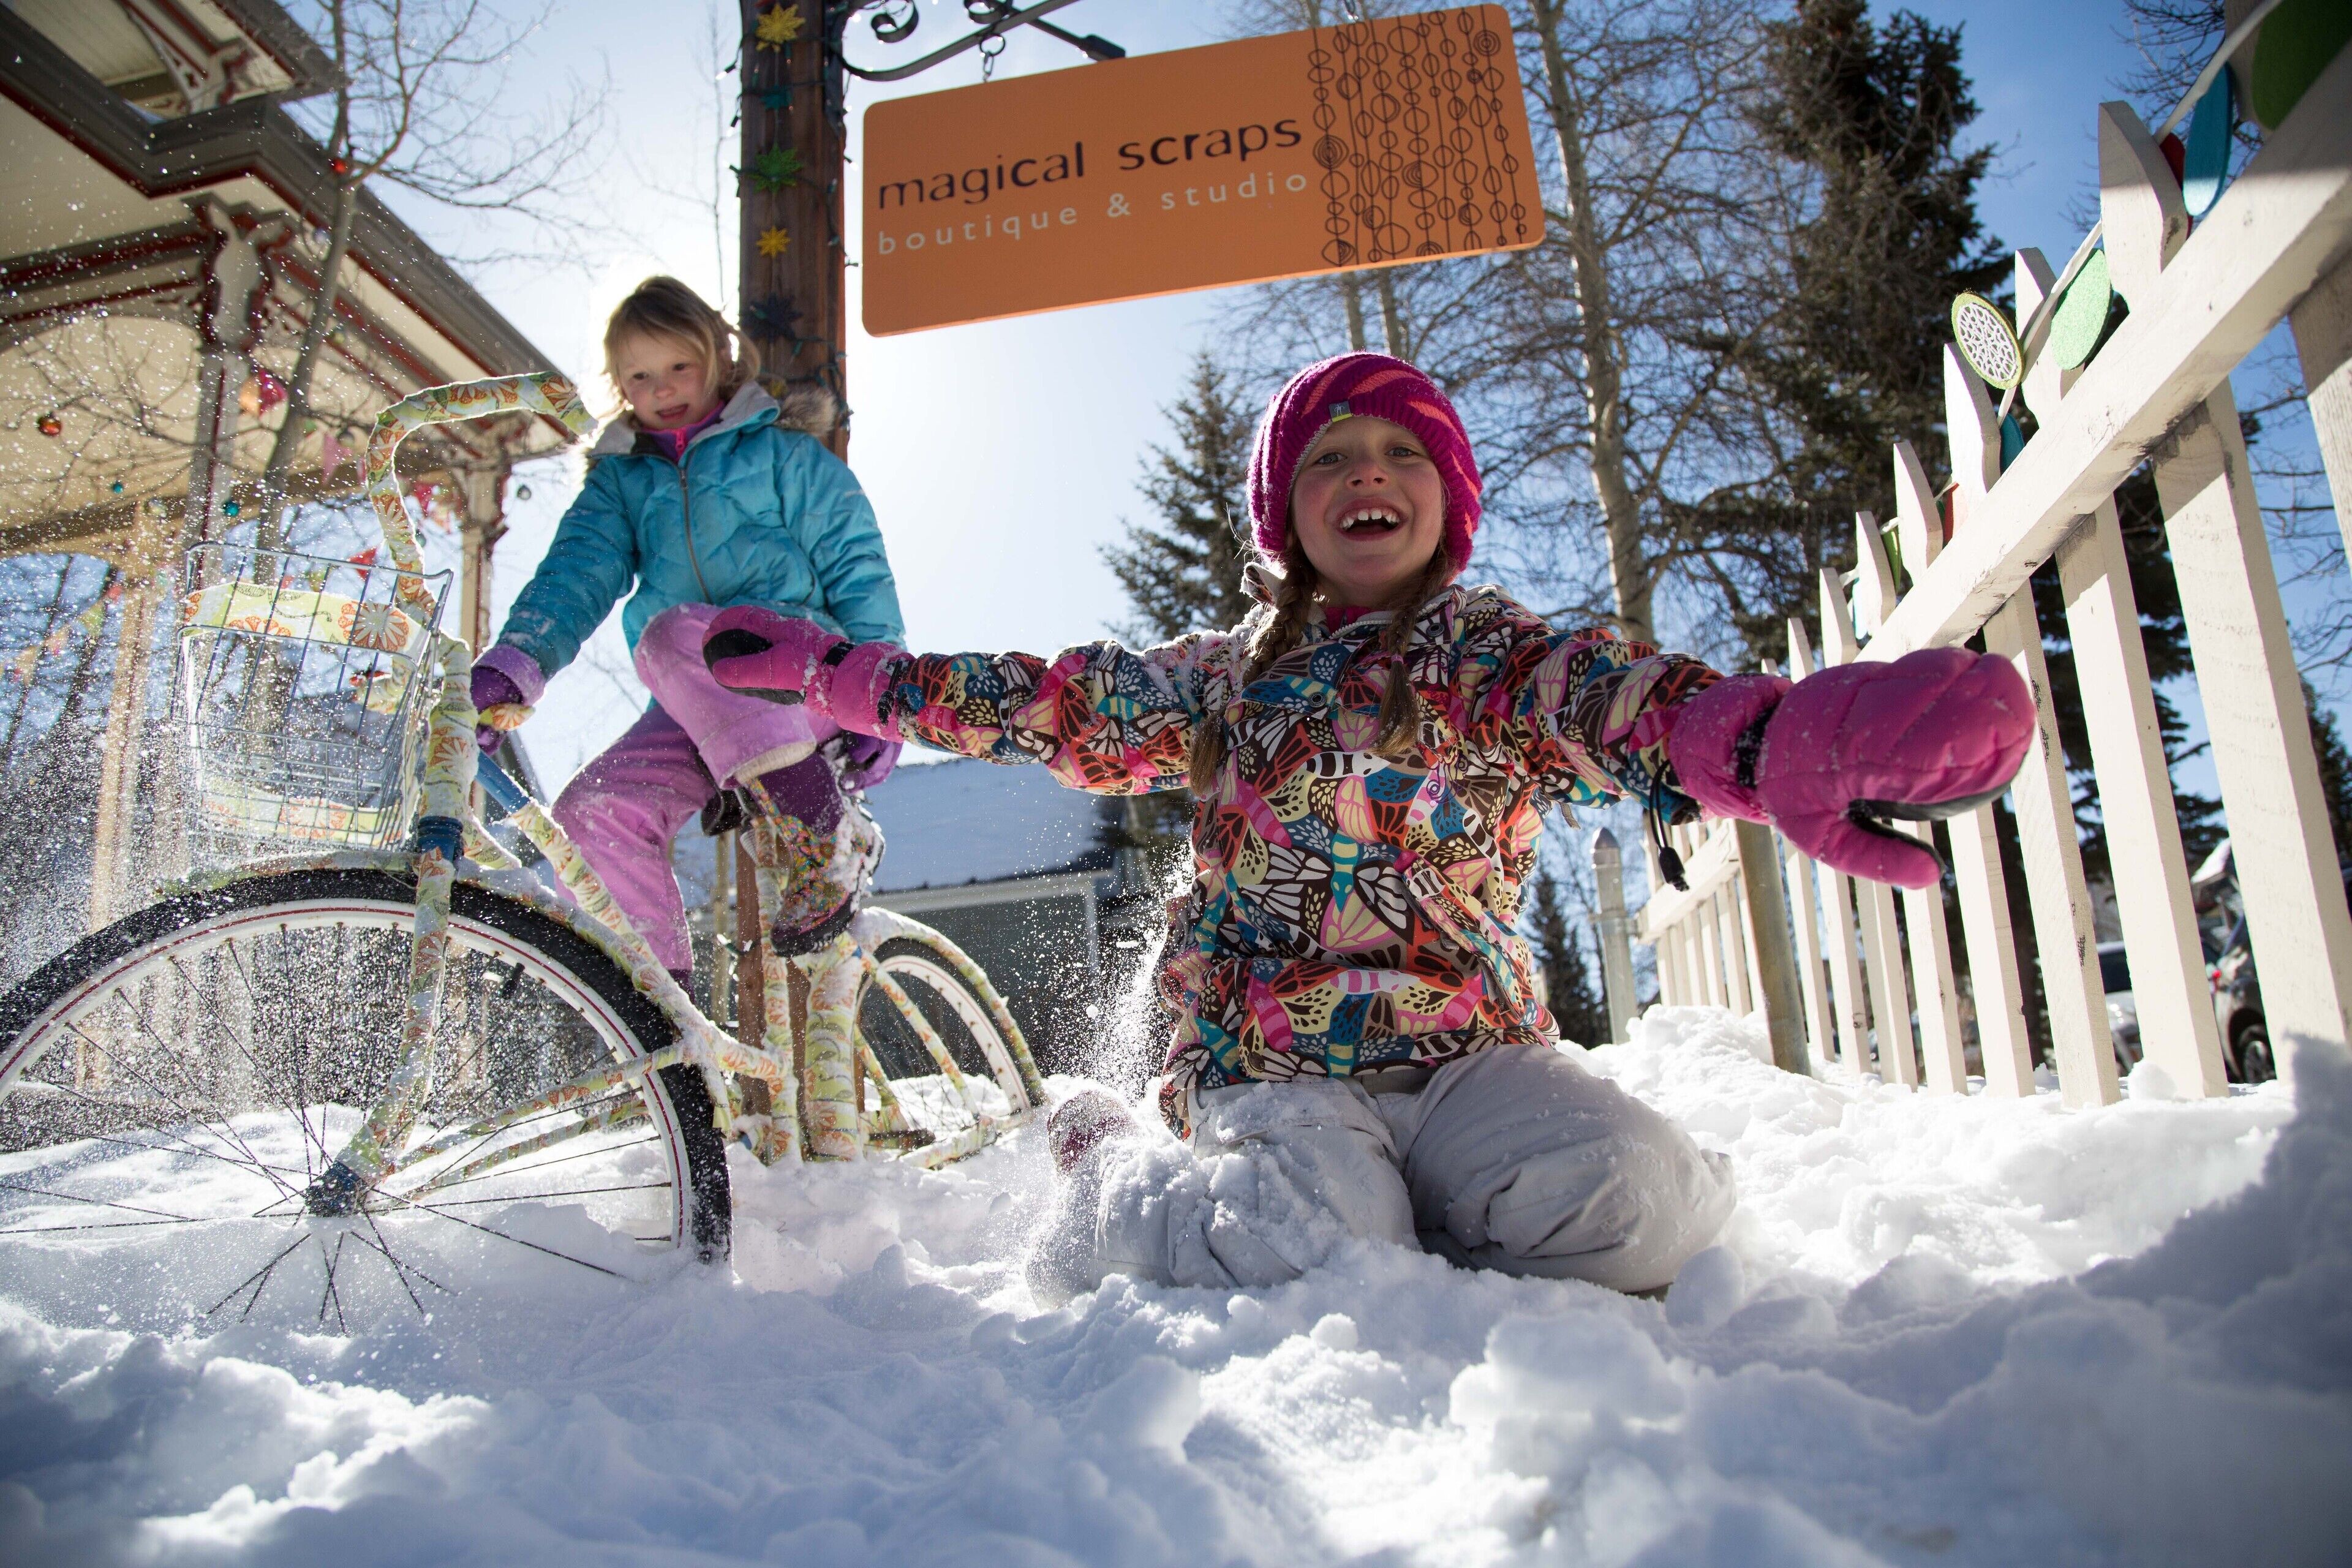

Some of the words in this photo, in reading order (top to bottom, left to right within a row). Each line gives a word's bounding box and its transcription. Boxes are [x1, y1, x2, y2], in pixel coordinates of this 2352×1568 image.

[878, 140, 1085, 210] magical
[1117, 118, 1303, 172] scraps
[878, 207, 1077, 255] boutique
[1107, 192, 1131, 217] &
[1161, 172, 1307, 209] studio
